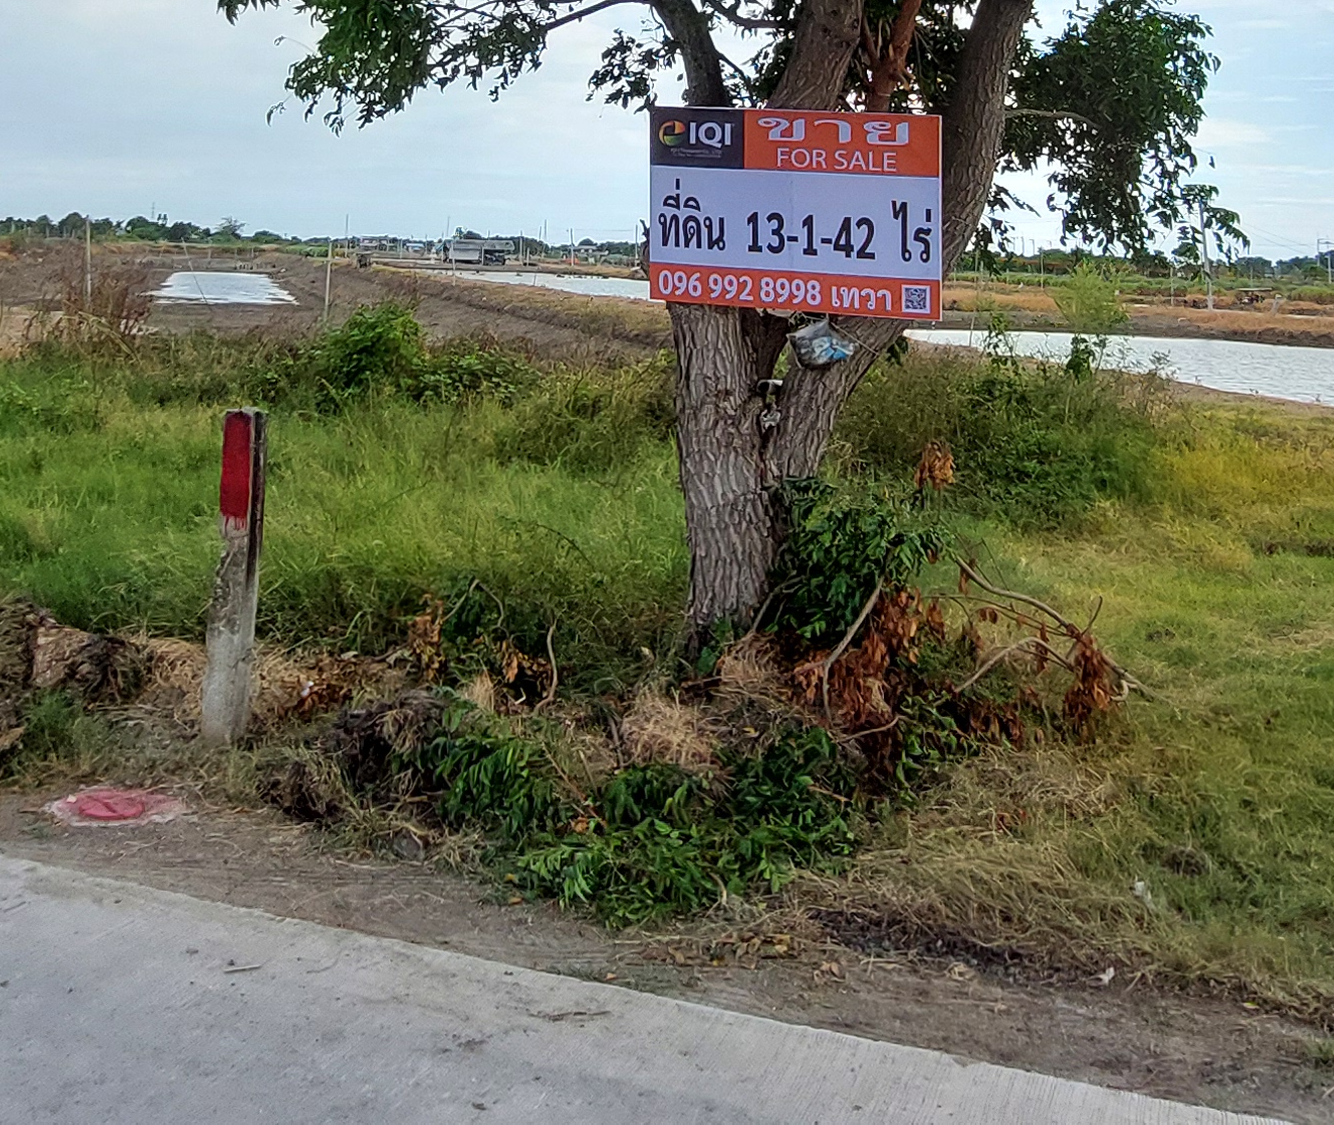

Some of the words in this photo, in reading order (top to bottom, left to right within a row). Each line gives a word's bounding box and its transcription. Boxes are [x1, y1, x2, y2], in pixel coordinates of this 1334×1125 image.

[689, 121, 731, 148] IQI
[757, 117, 910, 146] ขาย
[777, 147, 827, 169] FOR
[834, 150, 897, 172] SALE
[658, 178, 726, 251] ที่ดิน
[746, 212, 876, 260] 13-1-42
[891, 199, 932, 263] ไร่
[658, 269, 702, 297] 096
[709, 274, 753, 301] 992
[760, 277, 821, 305] 8998
[831, 286, 891, 311] เทวา
